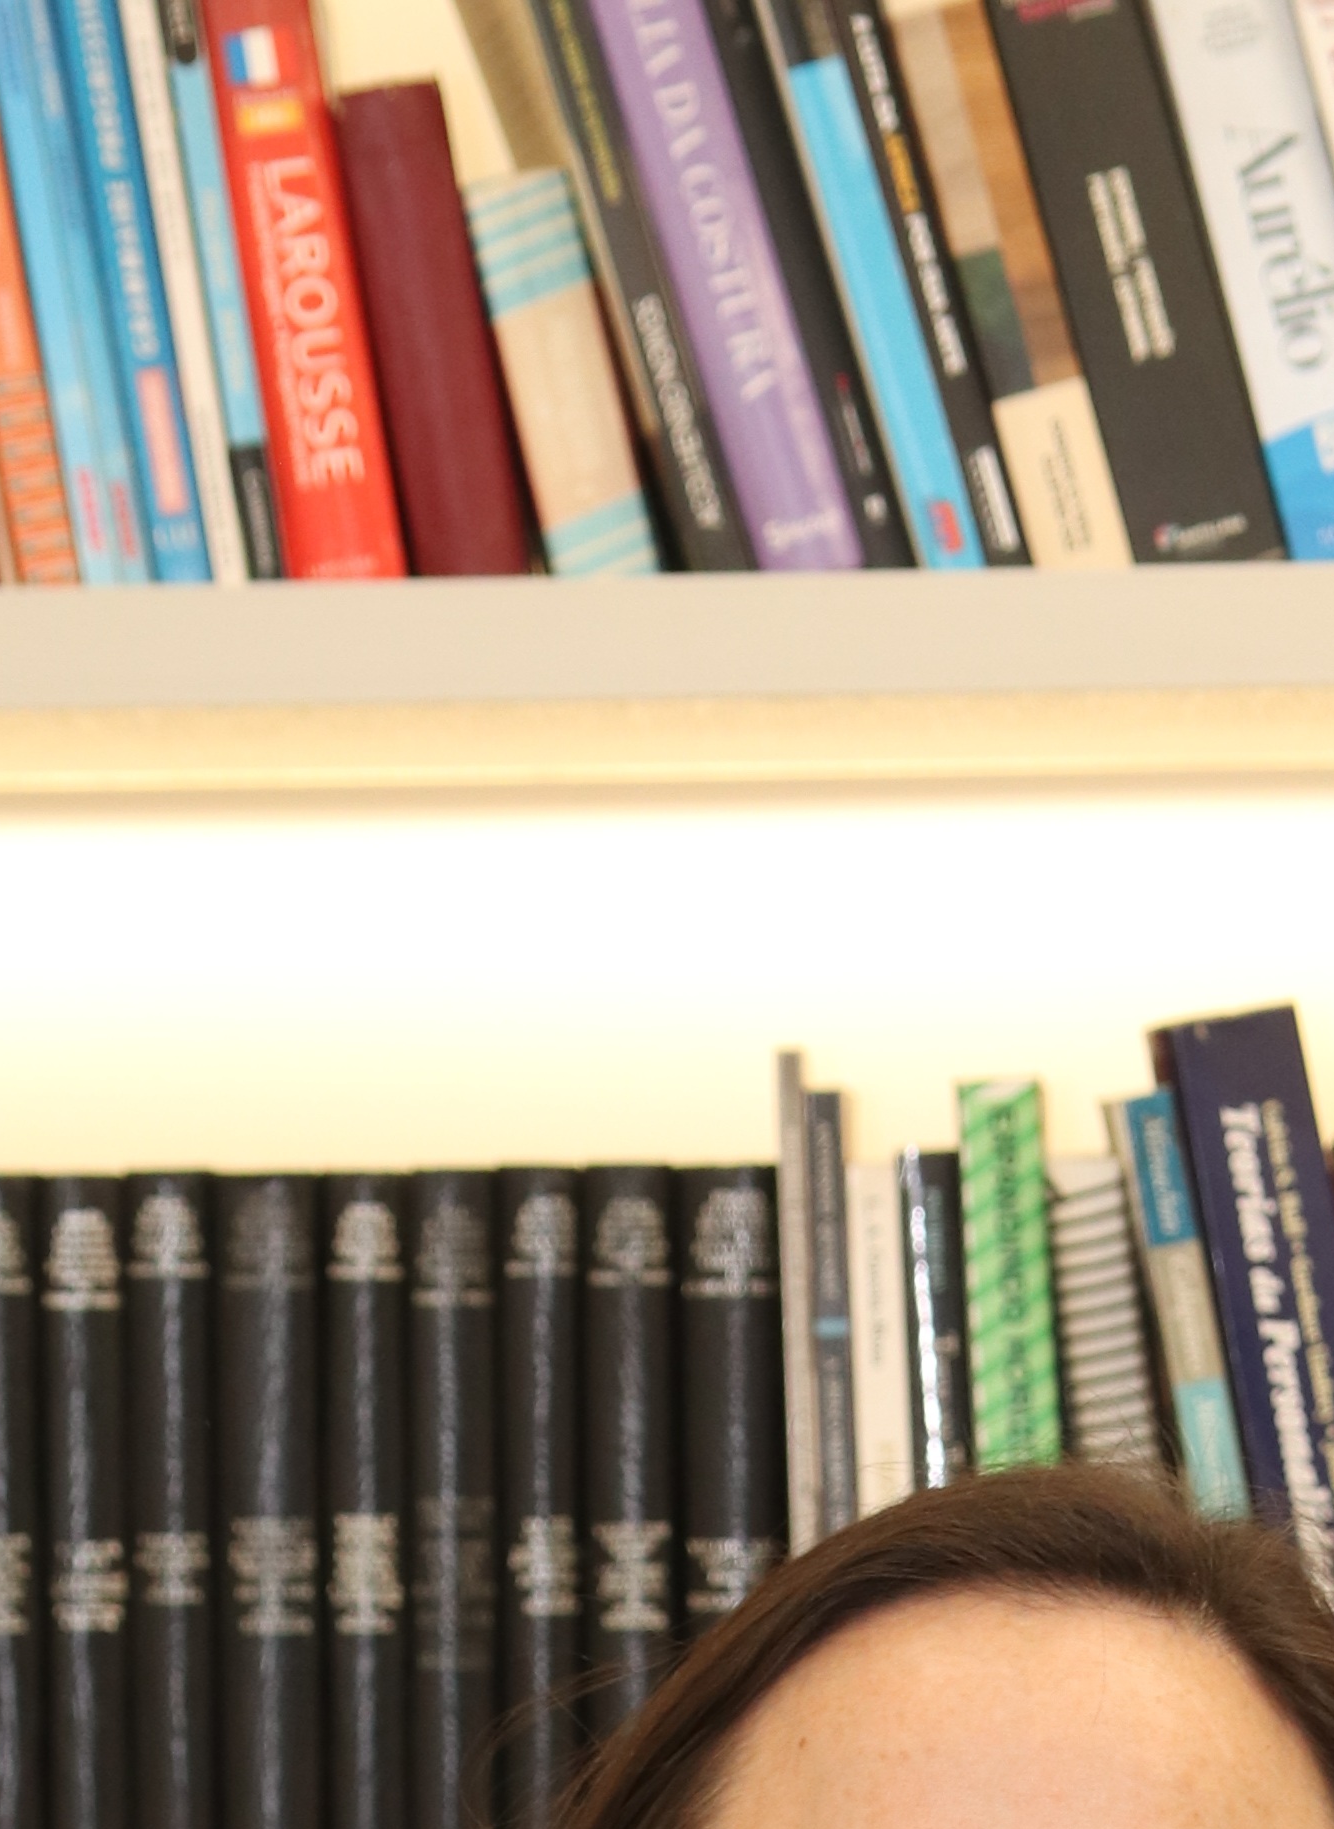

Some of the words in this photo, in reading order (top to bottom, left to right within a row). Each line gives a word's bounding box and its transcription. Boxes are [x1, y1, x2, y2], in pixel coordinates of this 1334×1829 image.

[258, 150, 367, 491] LAROUSSE
[667, 154, 796, 404] COSTURA
[1216, 1099, 1286, 1267] Teorias
[1245, 1261, 1289, 1318] da
